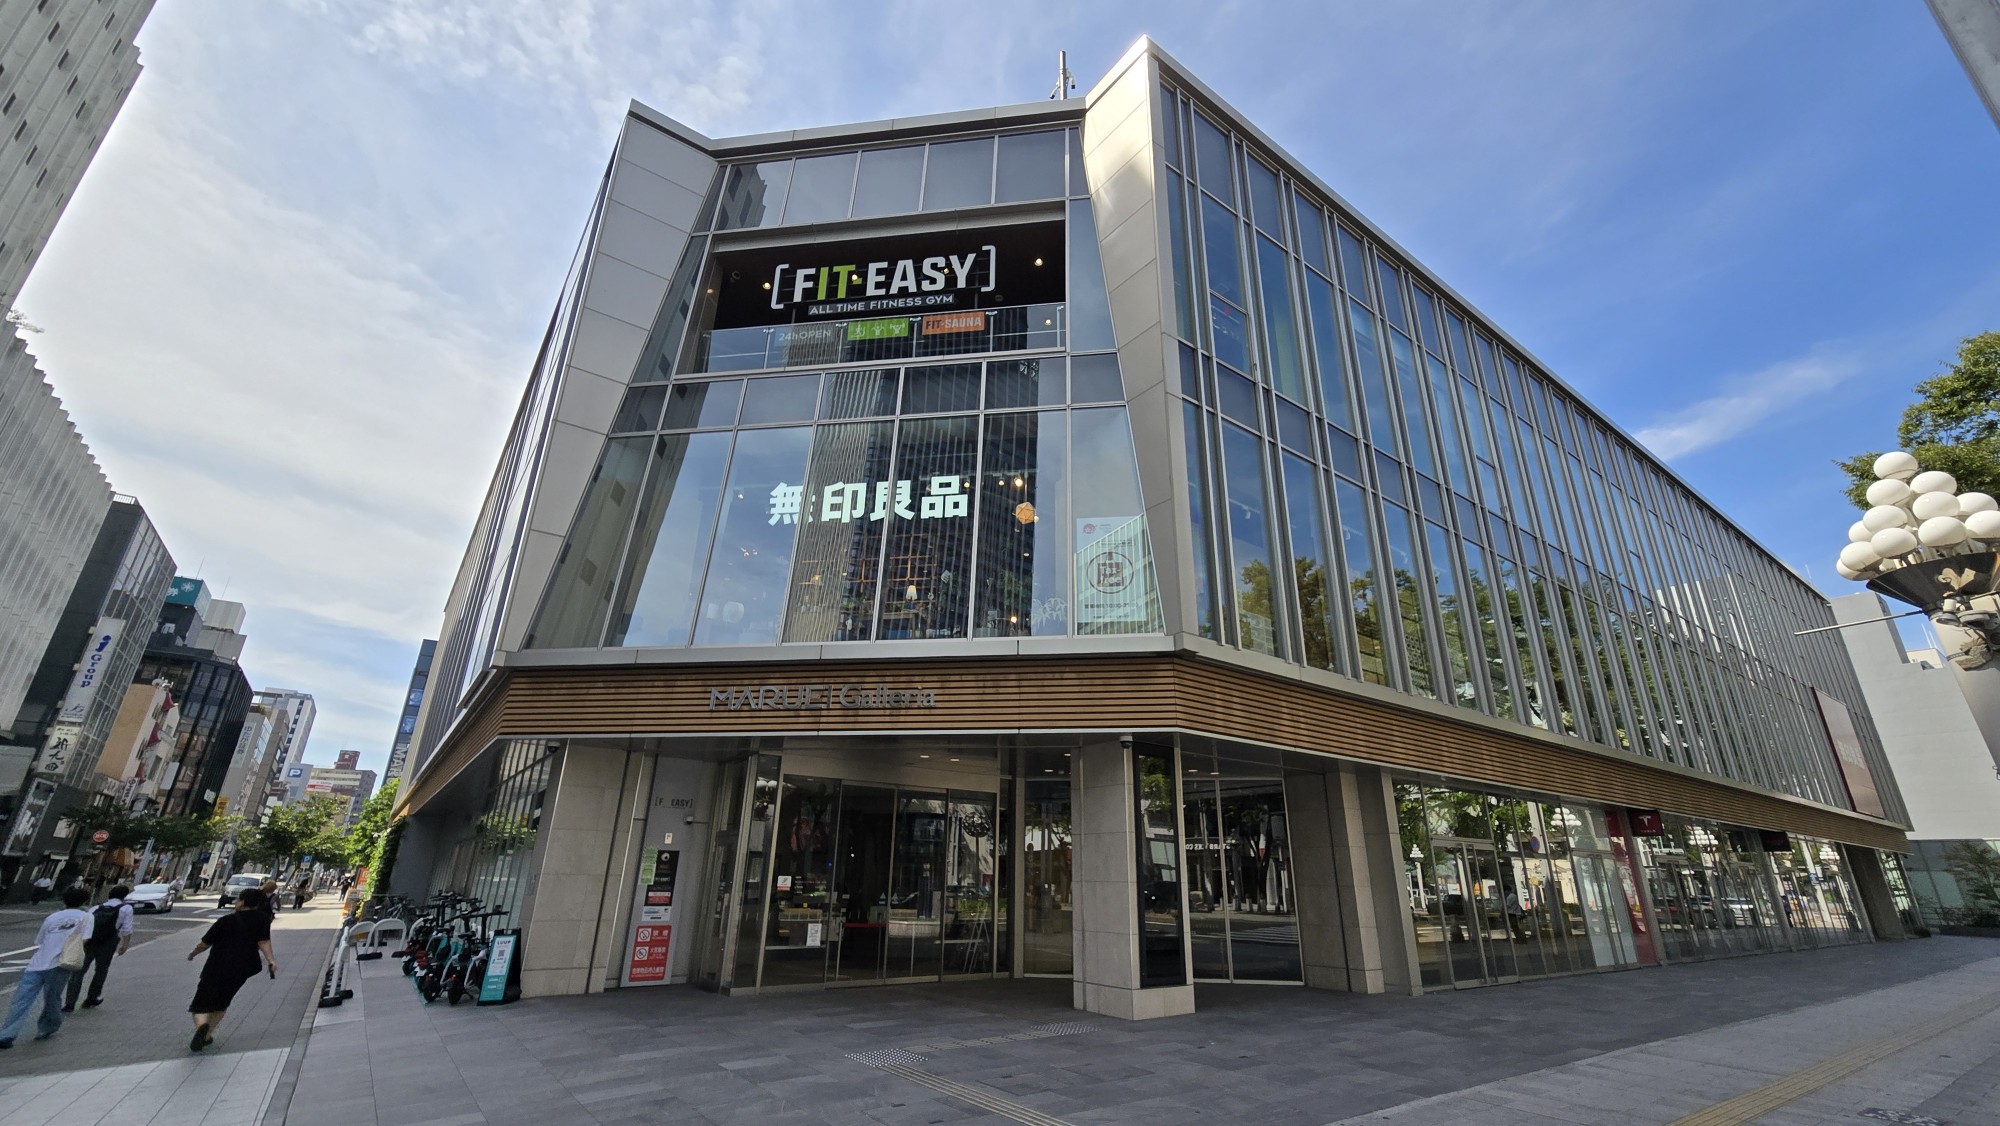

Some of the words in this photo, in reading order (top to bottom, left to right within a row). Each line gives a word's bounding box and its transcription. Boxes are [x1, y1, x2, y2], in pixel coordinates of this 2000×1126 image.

[808, 306, 834, 316] ALL
[836, 302, 866, 312] TIME
[869, 297, 923, 310] FITNESS
[925, 294, 954, 305] GYM
[767, 474, 969, 527] 無印良品
[708, 684, 833, 711] MARUEI
[839, 684, 937, 710] Galleria
[289, 769, 302, 778] P
